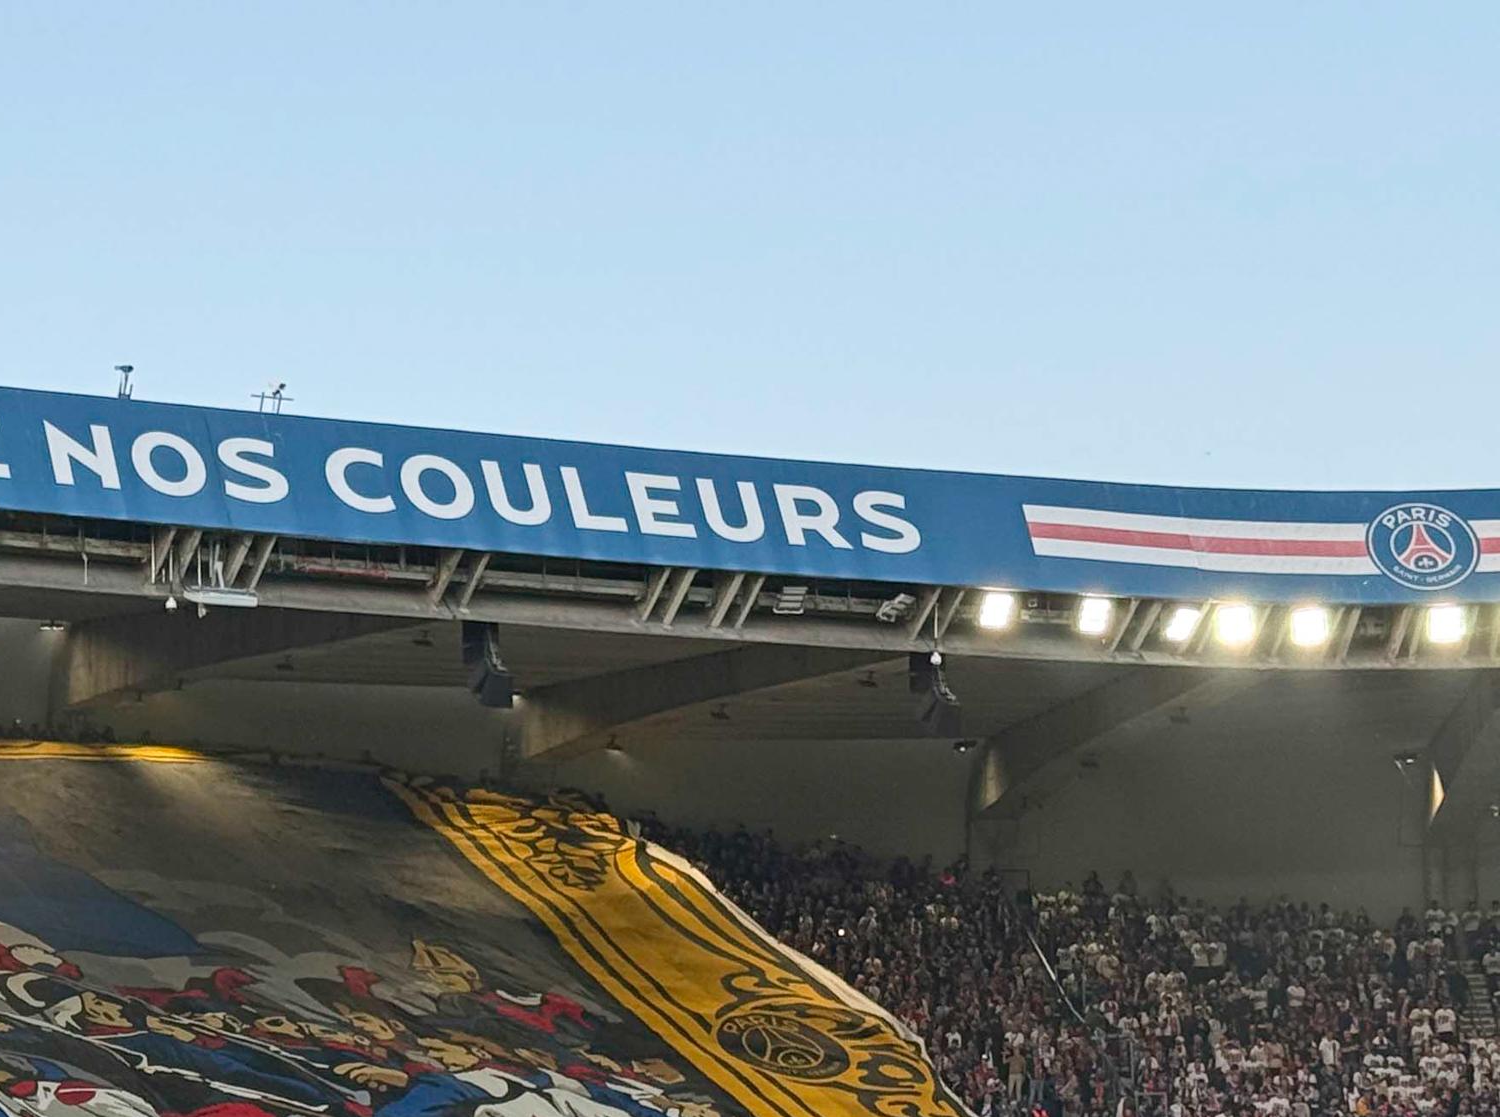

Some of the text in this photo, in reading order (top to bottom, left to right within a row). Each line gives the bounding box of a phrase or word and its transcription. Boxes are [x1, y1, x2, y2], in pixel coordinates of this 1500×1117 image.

[41, 418, 290, 504] NOS
[324, 446, 923, 555] COULEURS
[1381, 506, 1453, 530] PARIS
